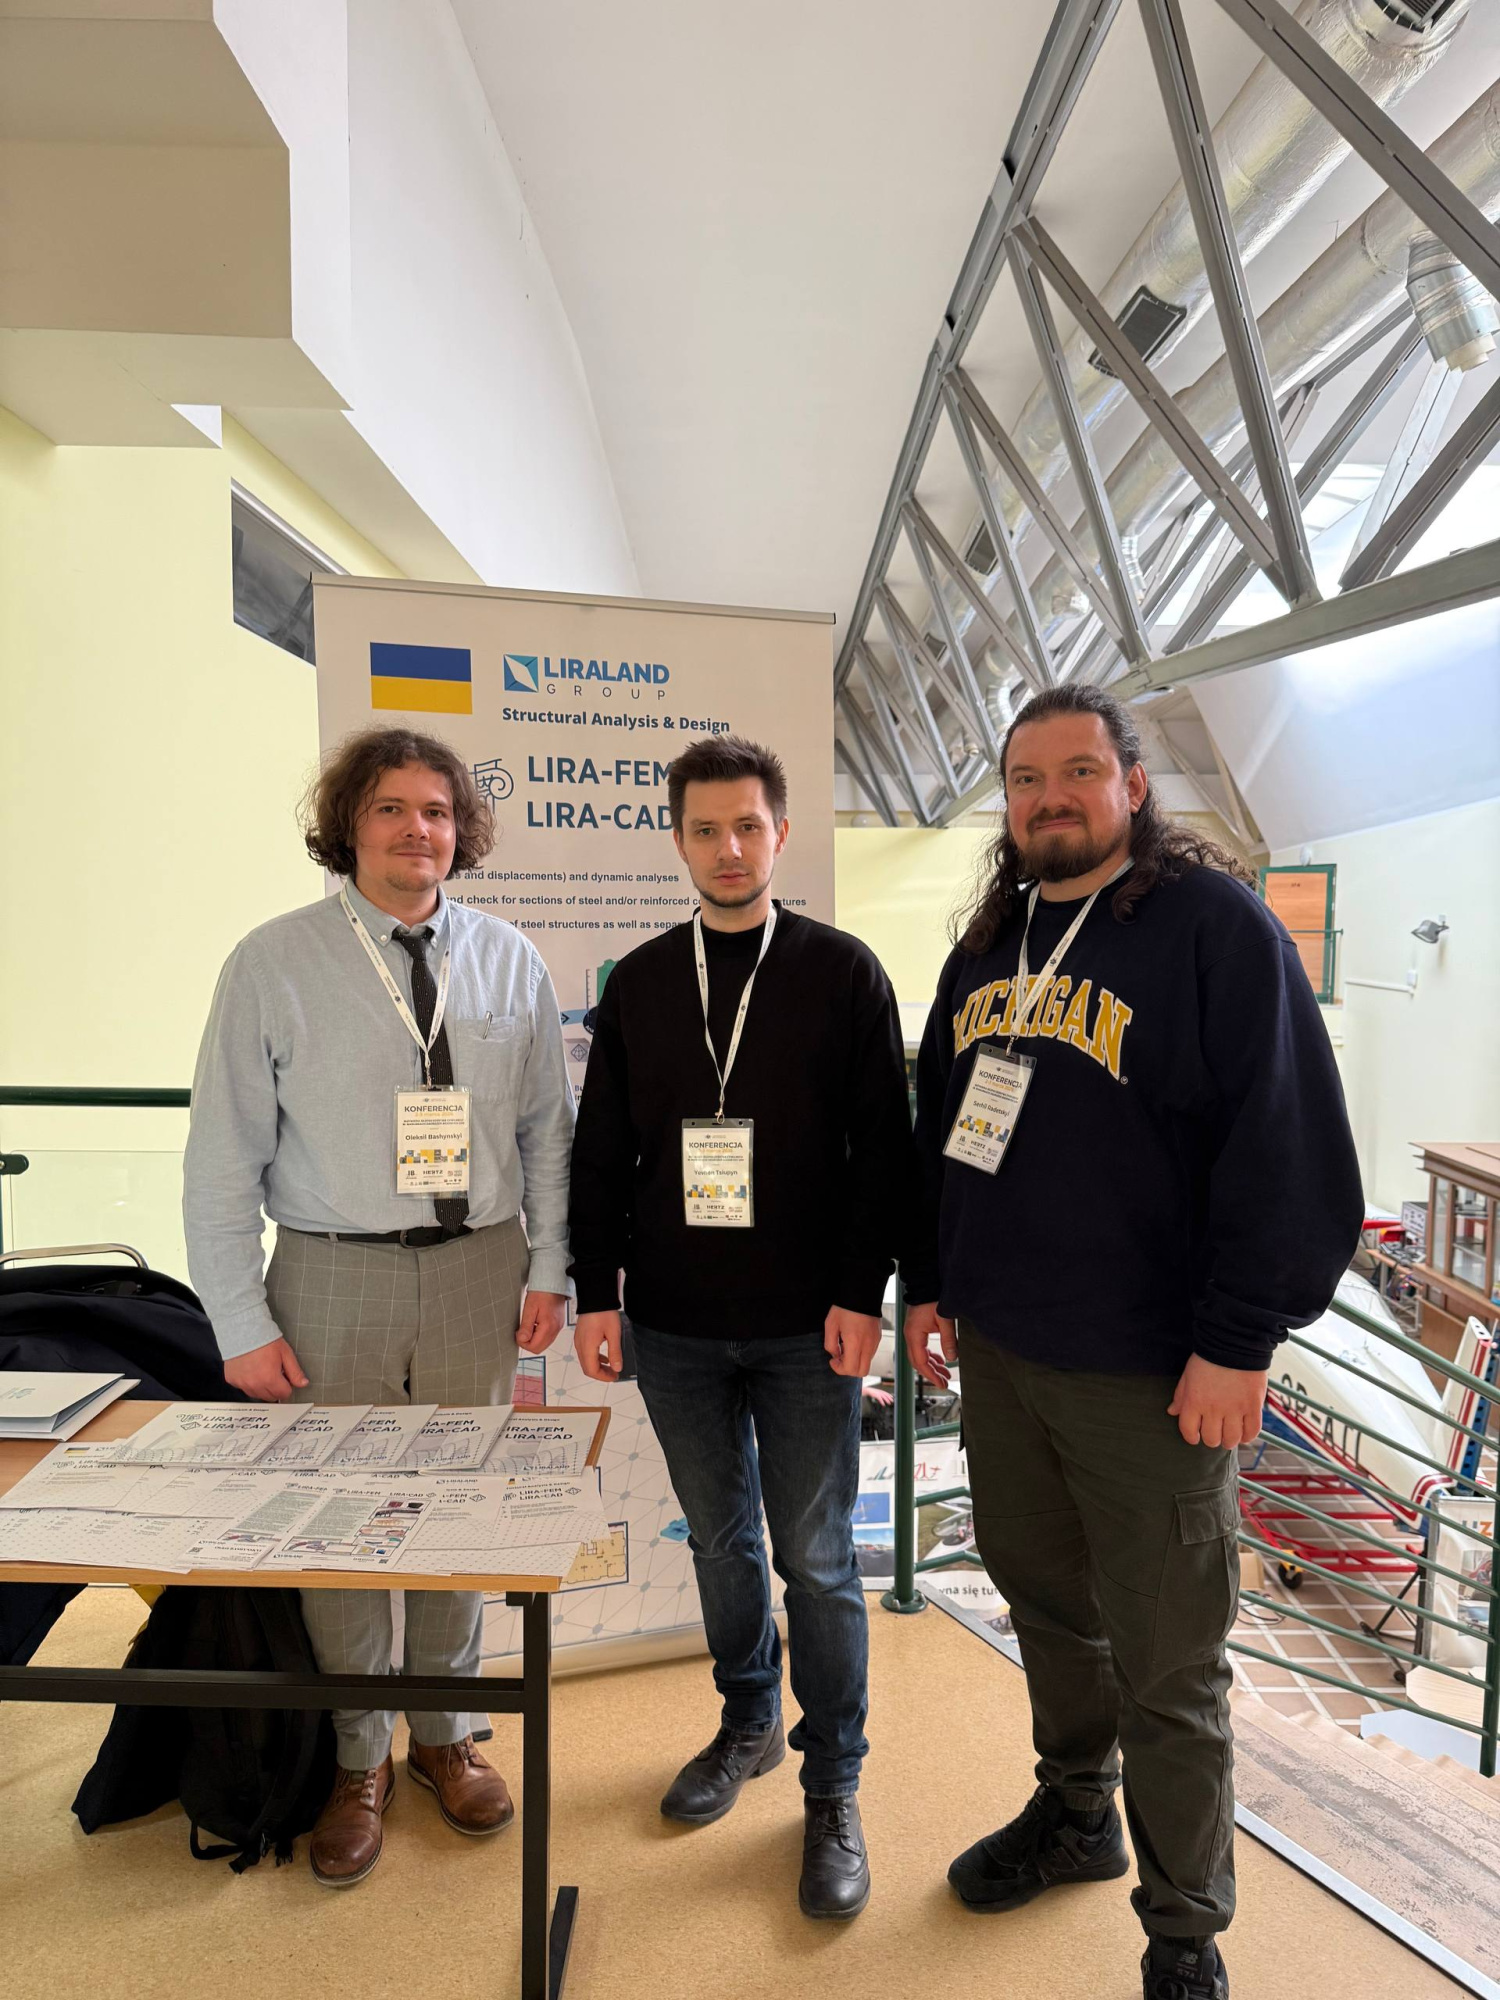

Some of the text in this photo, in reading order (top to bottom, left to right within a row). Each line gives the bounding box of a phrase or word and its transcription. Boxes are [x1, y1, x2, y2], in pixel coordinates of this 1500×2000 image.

[544, 657, 670, 685] LIRALAND
[546, 684, 665, 700] GROUP
[502, 707, 730, 734] Structural Analysis & Design
[527, 801, 673, 830] LIRA-CAD
[464, 871, 484, 880] and
[488, 871, 567, 883] displacements)
[569, 872, 588, 881] and
[591, 872, 634, 883] dynamic
[636, 873, 679, 884] analyses
[467, 895, 499, 904] check
[502, 895, 517, 904] for
[519, 895, 563, 905] sections
[565, 896, 577, 905] of
[579, 896, 603, 905] steel
[605, 896, 637, 906] and/or
[640, 896, 690, 906] reinforced
[782, 898, 807, 906] tures
[521, 920, 545, 929] steel
[549, 920, 600, 929] structures
[617, 920, 637, 929] well
[953, 975, 1133, 1081] MICHIGAN
[979, 1070, 1023, 1089] KONFERENCJA
[420, 1426, 481, 1434] IRA-CAD
[519, 1487, 562, 1496] LIRA-FEM
